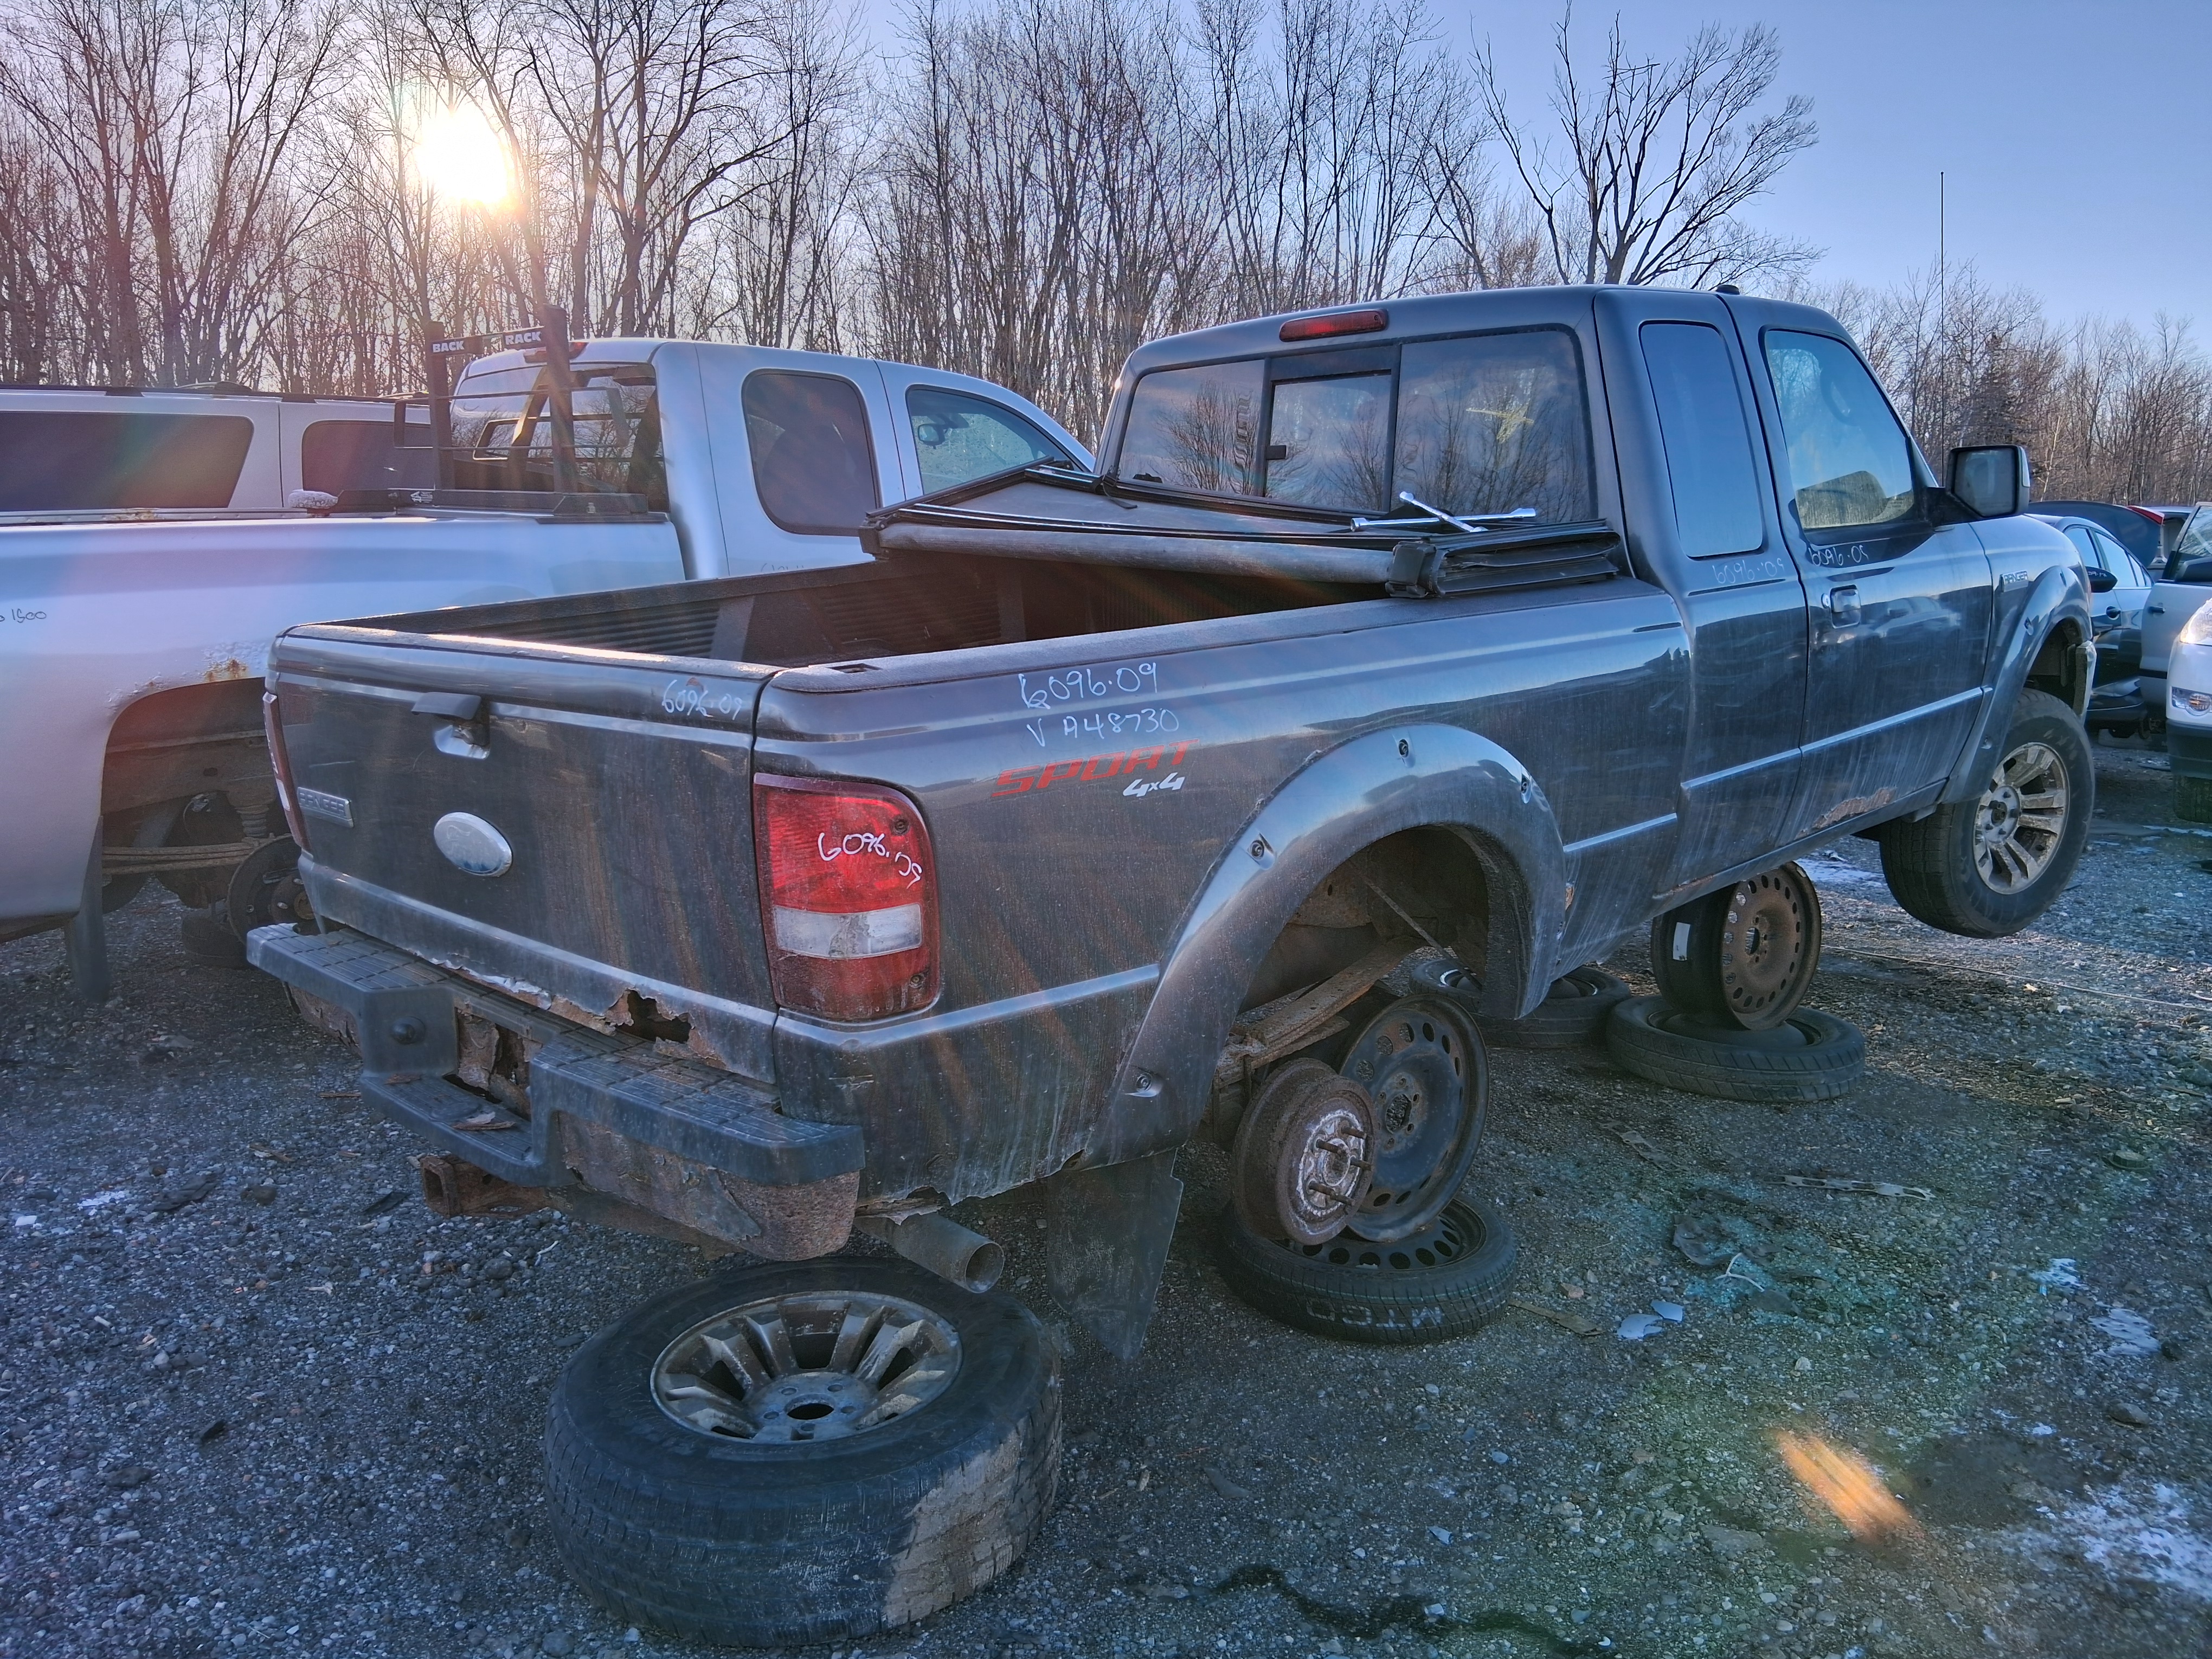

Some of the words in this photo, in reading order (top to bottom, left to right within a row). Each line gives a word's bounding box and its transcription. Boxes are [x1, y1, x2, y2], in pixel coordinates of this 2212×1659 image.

[432, 340, 465, 353] BACK
[505, 331, 541, 345] RACK
[11, 608, 47, 623] 1500
[1019, 663, 1158, 710] 6096.09
[1064, 708, 1179, 739] A48730
[992, 738, 1200, 797] SPORT
[1123, 772, 1186, 798] 4x4
